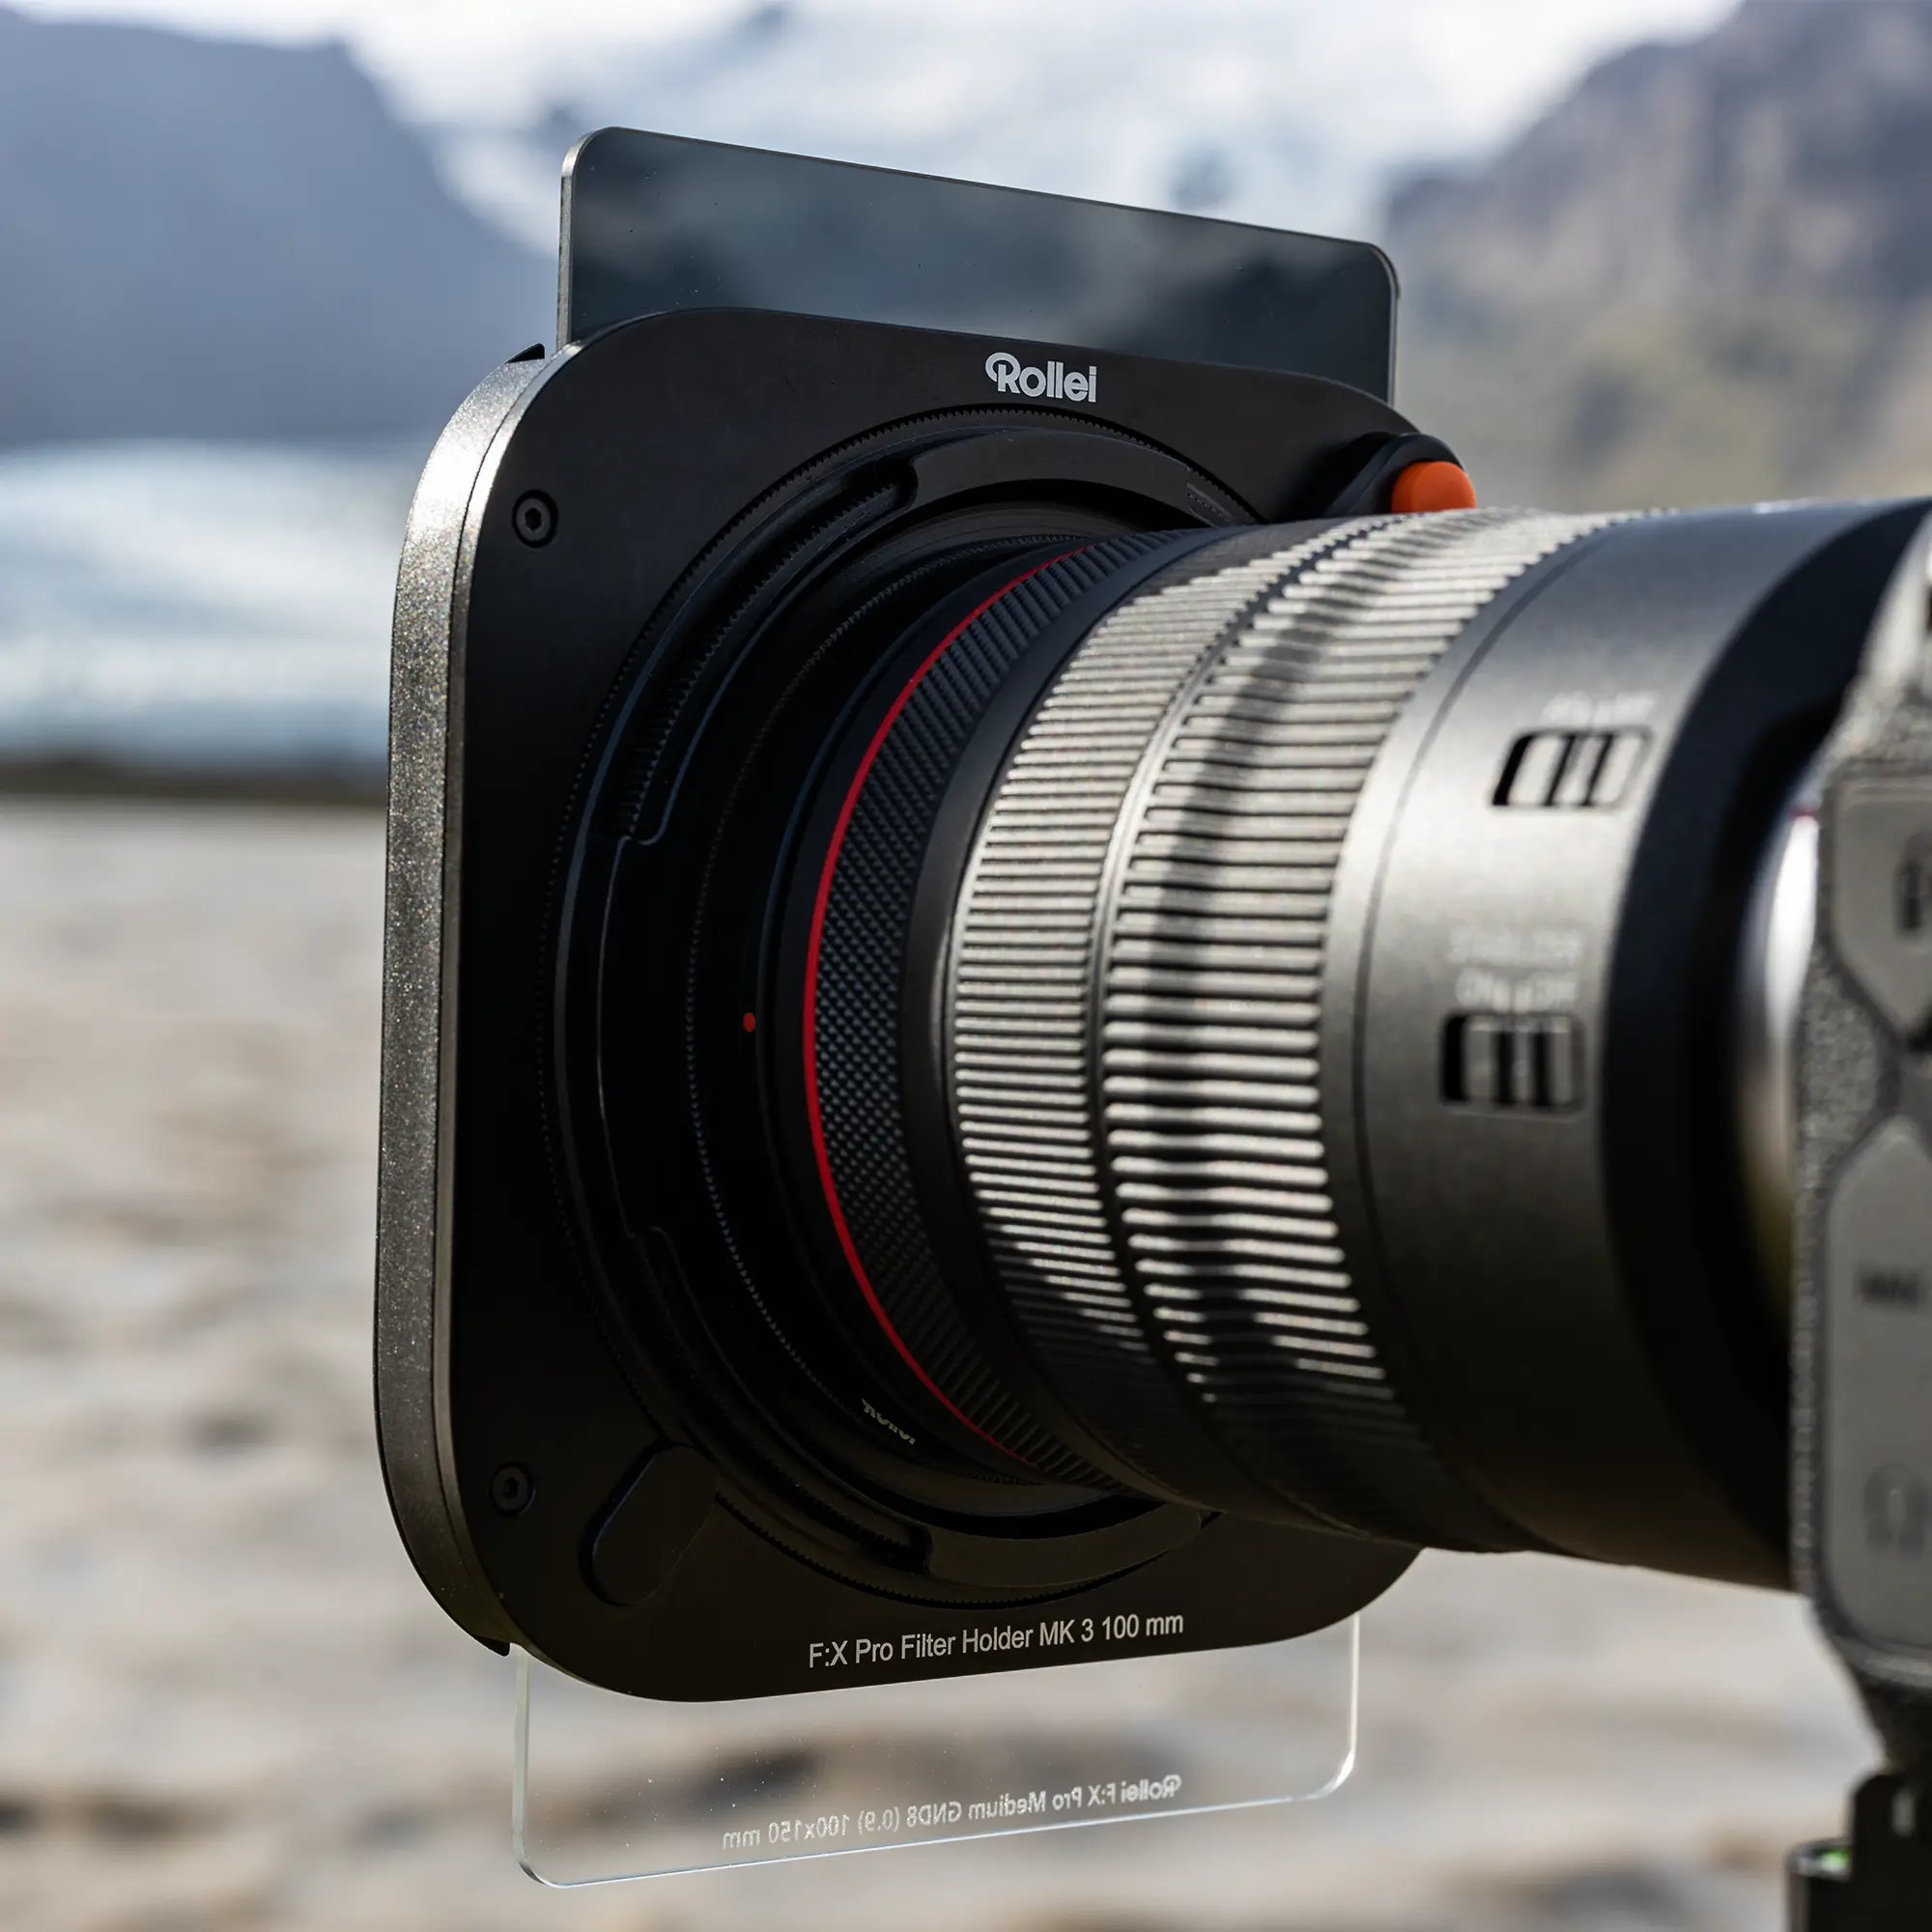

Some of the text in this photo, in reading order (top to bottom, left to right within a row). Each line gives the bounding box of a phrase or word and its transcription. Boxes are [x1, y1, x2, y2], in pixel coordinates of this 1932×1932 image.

[985, 352, 1097, 403] Rollei
[809, 1613, 1184, 1668] F:X Pro Filter Holder MK 3 100 mm
